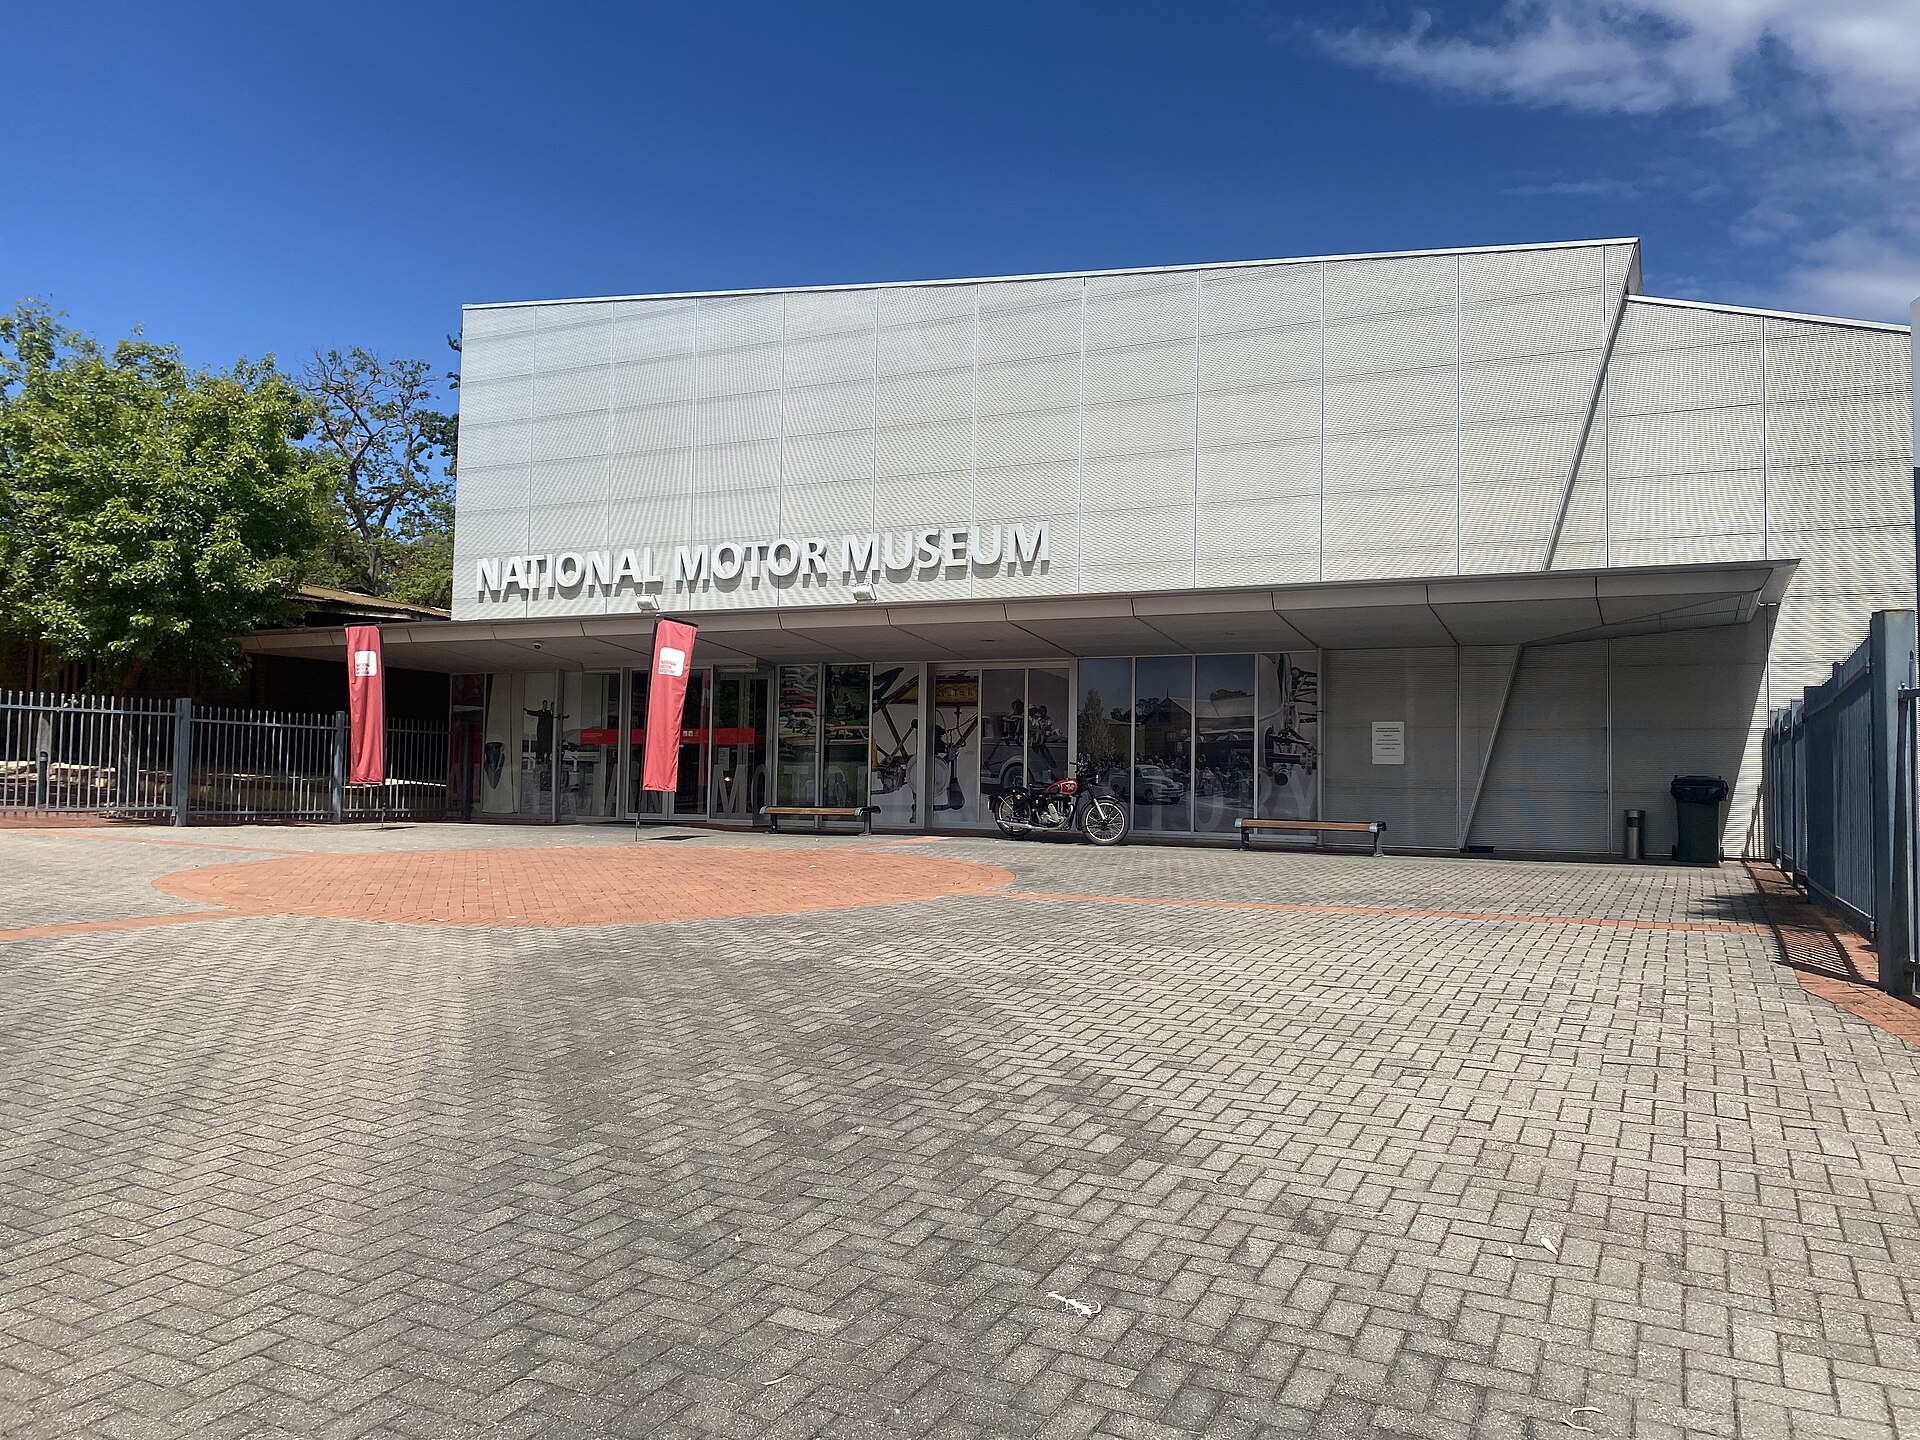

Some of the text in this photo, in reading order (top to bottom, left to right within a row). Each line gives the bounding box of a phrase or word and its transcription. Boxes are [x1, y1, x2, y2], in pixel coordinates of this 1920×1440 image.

[476, 521, 1051, 593] NATIONAL MOTOR MUSEUM
